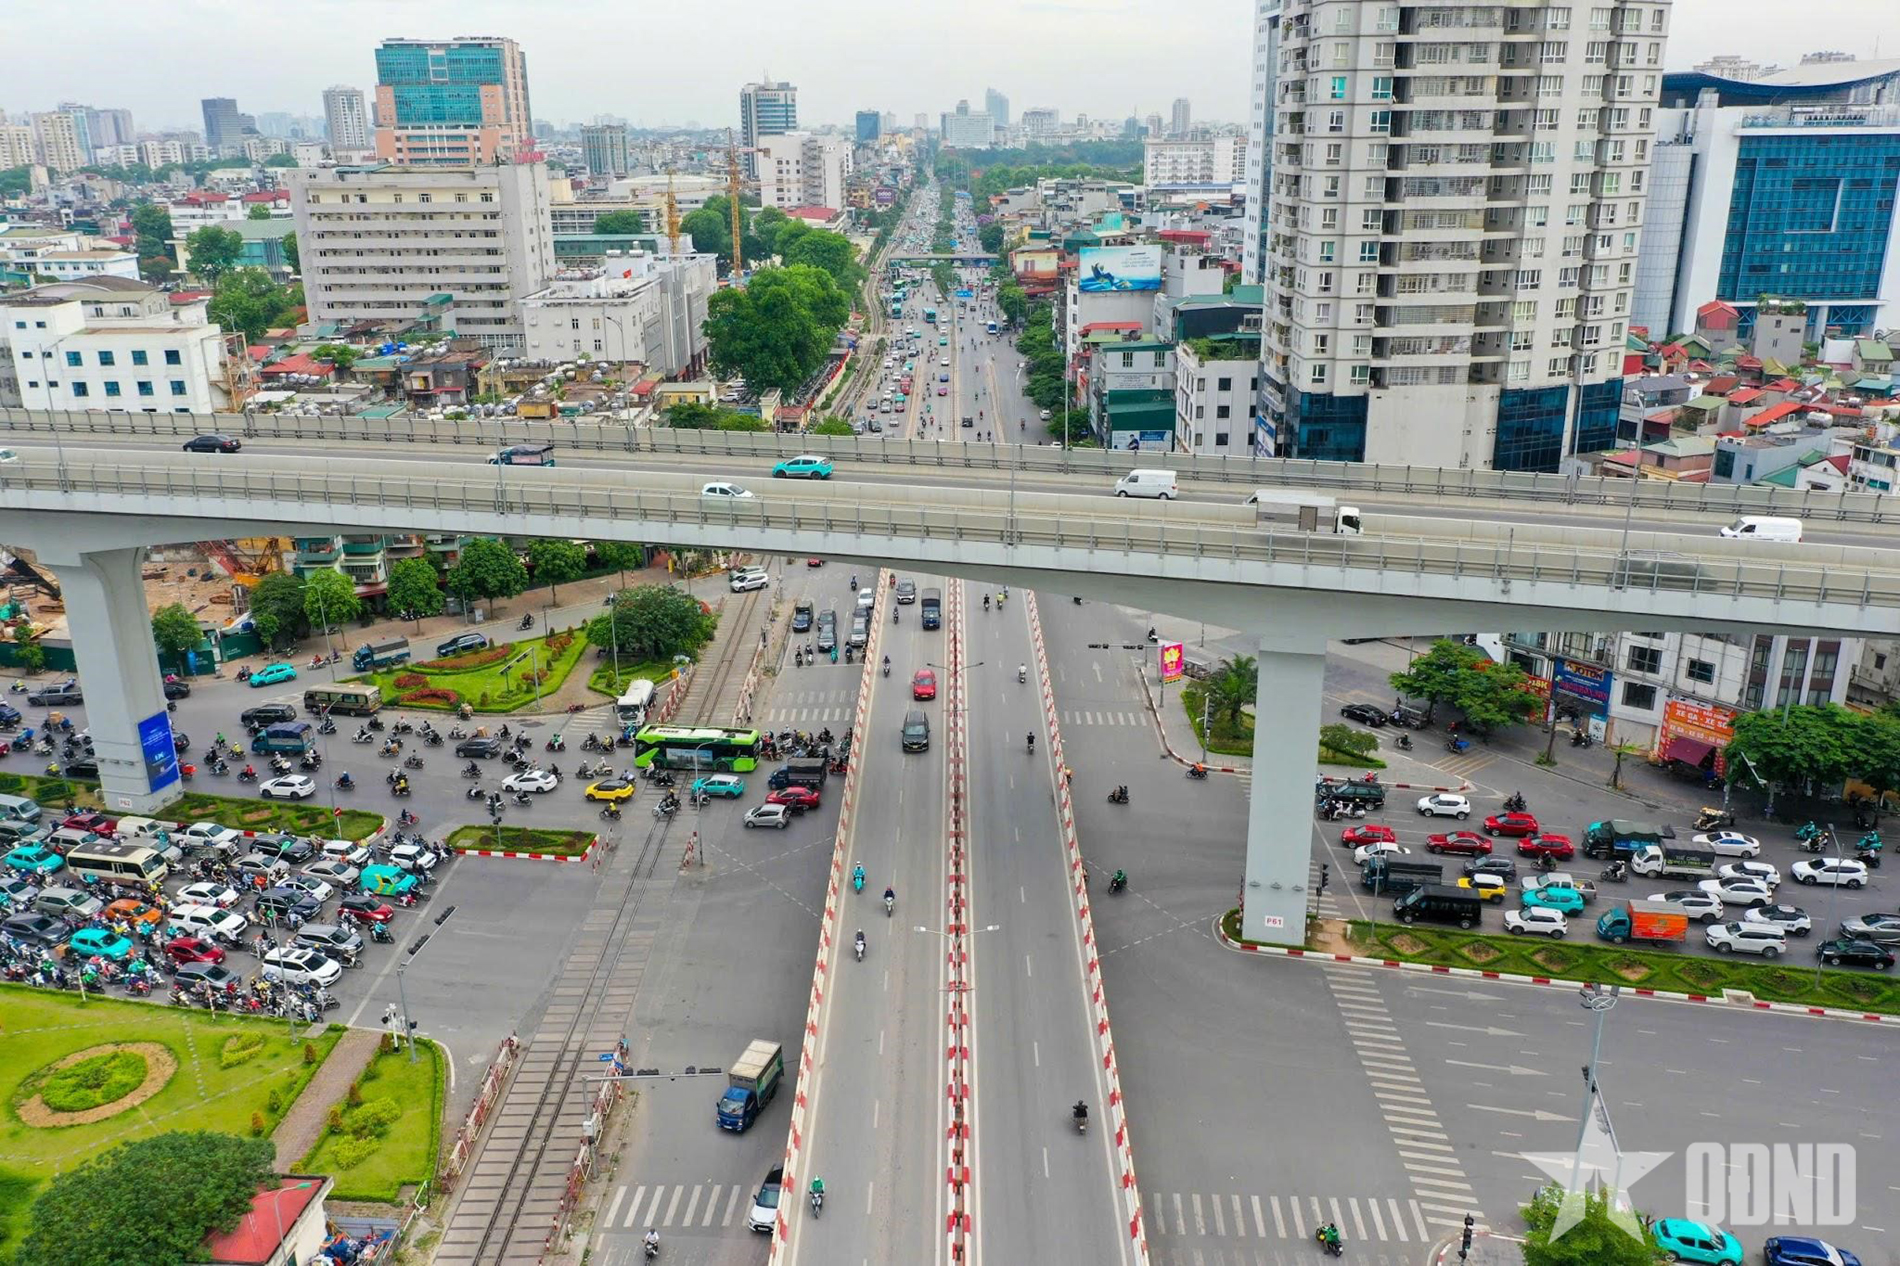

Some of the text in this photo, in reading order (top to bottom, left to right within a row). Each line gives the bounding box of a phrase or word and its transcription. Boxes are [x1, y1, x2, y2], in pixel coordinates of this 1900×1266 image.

[1573, 665, 1603, 680] JOTON
[1676, 709, 1686, 717] XE
[1687, 712, 1698, 721] GA
[1705, 717, 1715, 726] XE
[1266, 917, 1282, 925] P61
